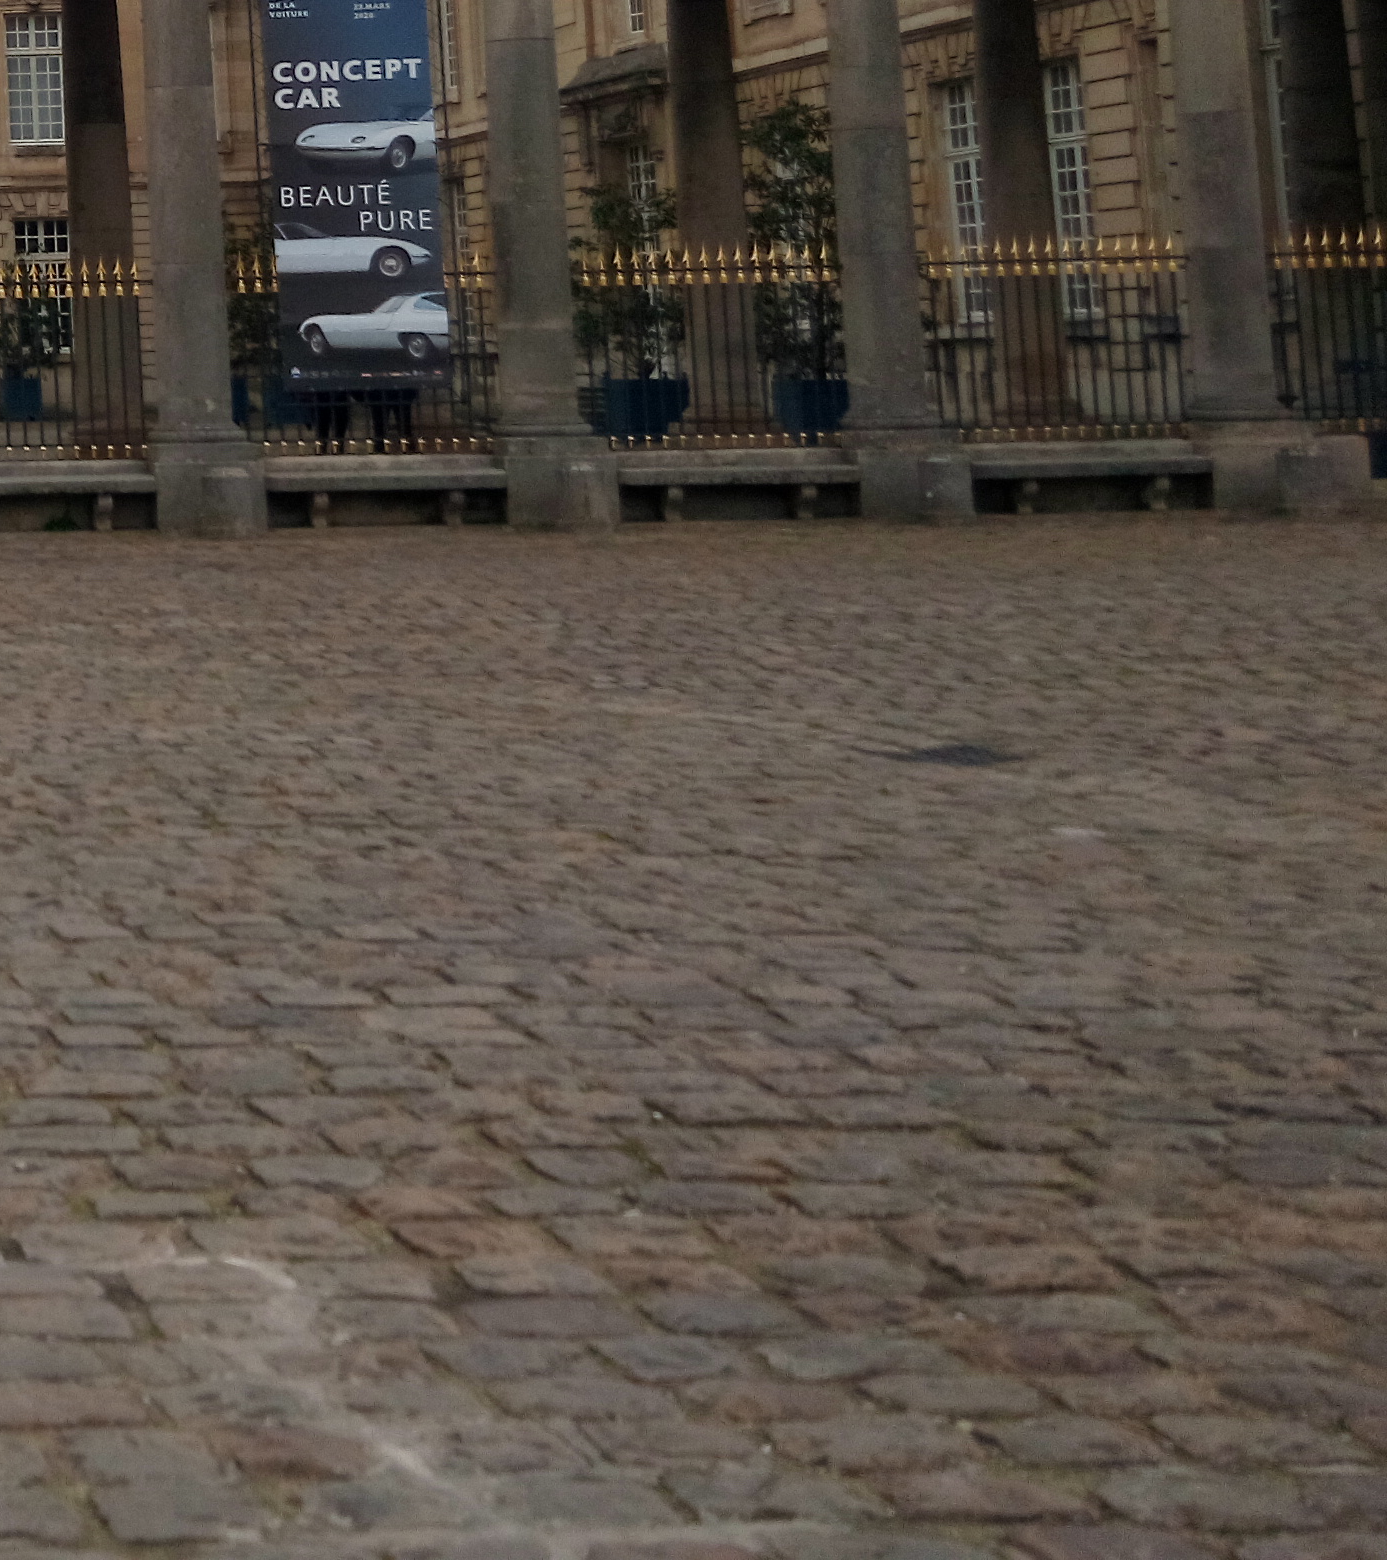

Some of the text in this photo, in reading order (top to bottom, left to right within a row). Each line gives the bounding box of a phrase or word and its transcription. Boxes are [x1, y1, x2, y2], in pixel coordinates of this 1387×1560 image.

[269, 10, 309, 18] VOITURE
[364, 2, 390, 10] MARS
[273, 58, 422, 83] CONCEPT
[274, 87, 341, 109] CAR
[280, 179, 392, 207] BEAUTÉ
[359, 209, 434, 231] PURE
